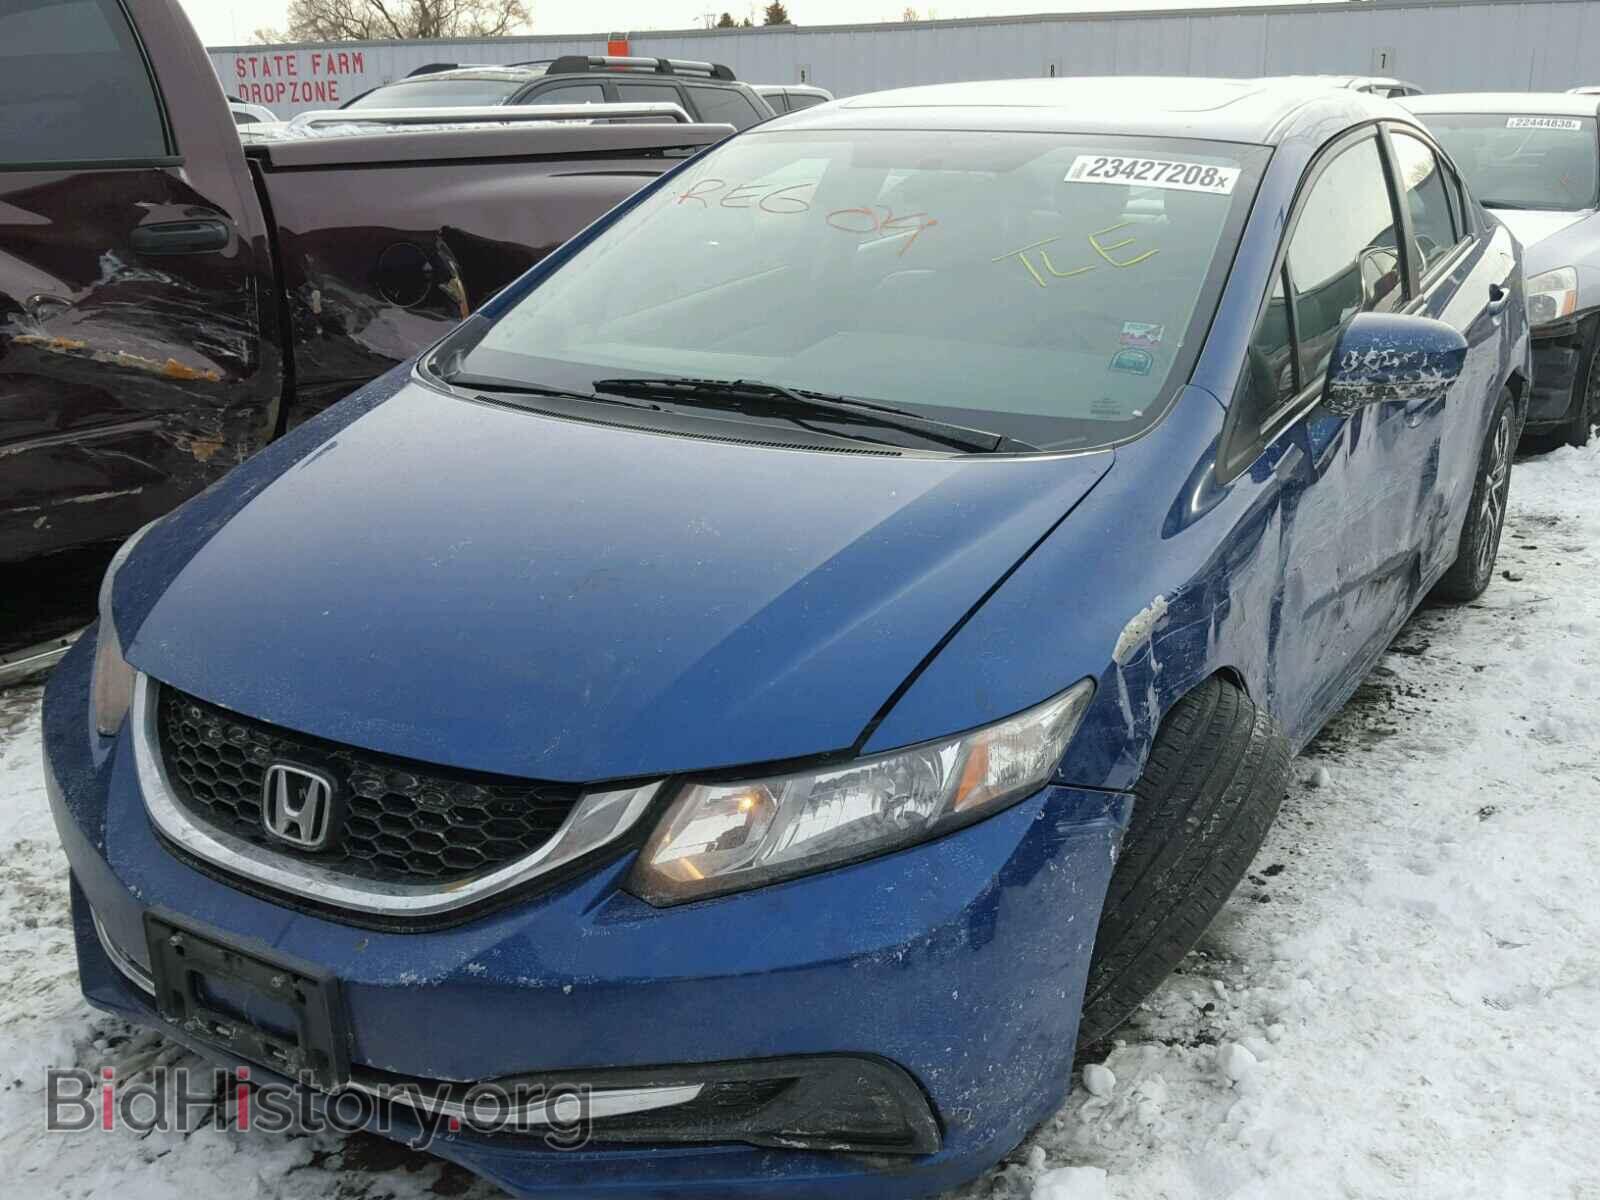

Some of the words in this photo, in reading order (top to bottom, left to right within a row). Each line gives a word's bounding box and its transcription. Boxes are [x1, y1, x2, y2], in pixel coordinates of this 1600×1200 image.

[236, 55, 297, 78] STATE
[312, 52, 365, 75] FARM
[238, 80, 340, 104] DROPZONE
[676, 178, 815, 214] REG
